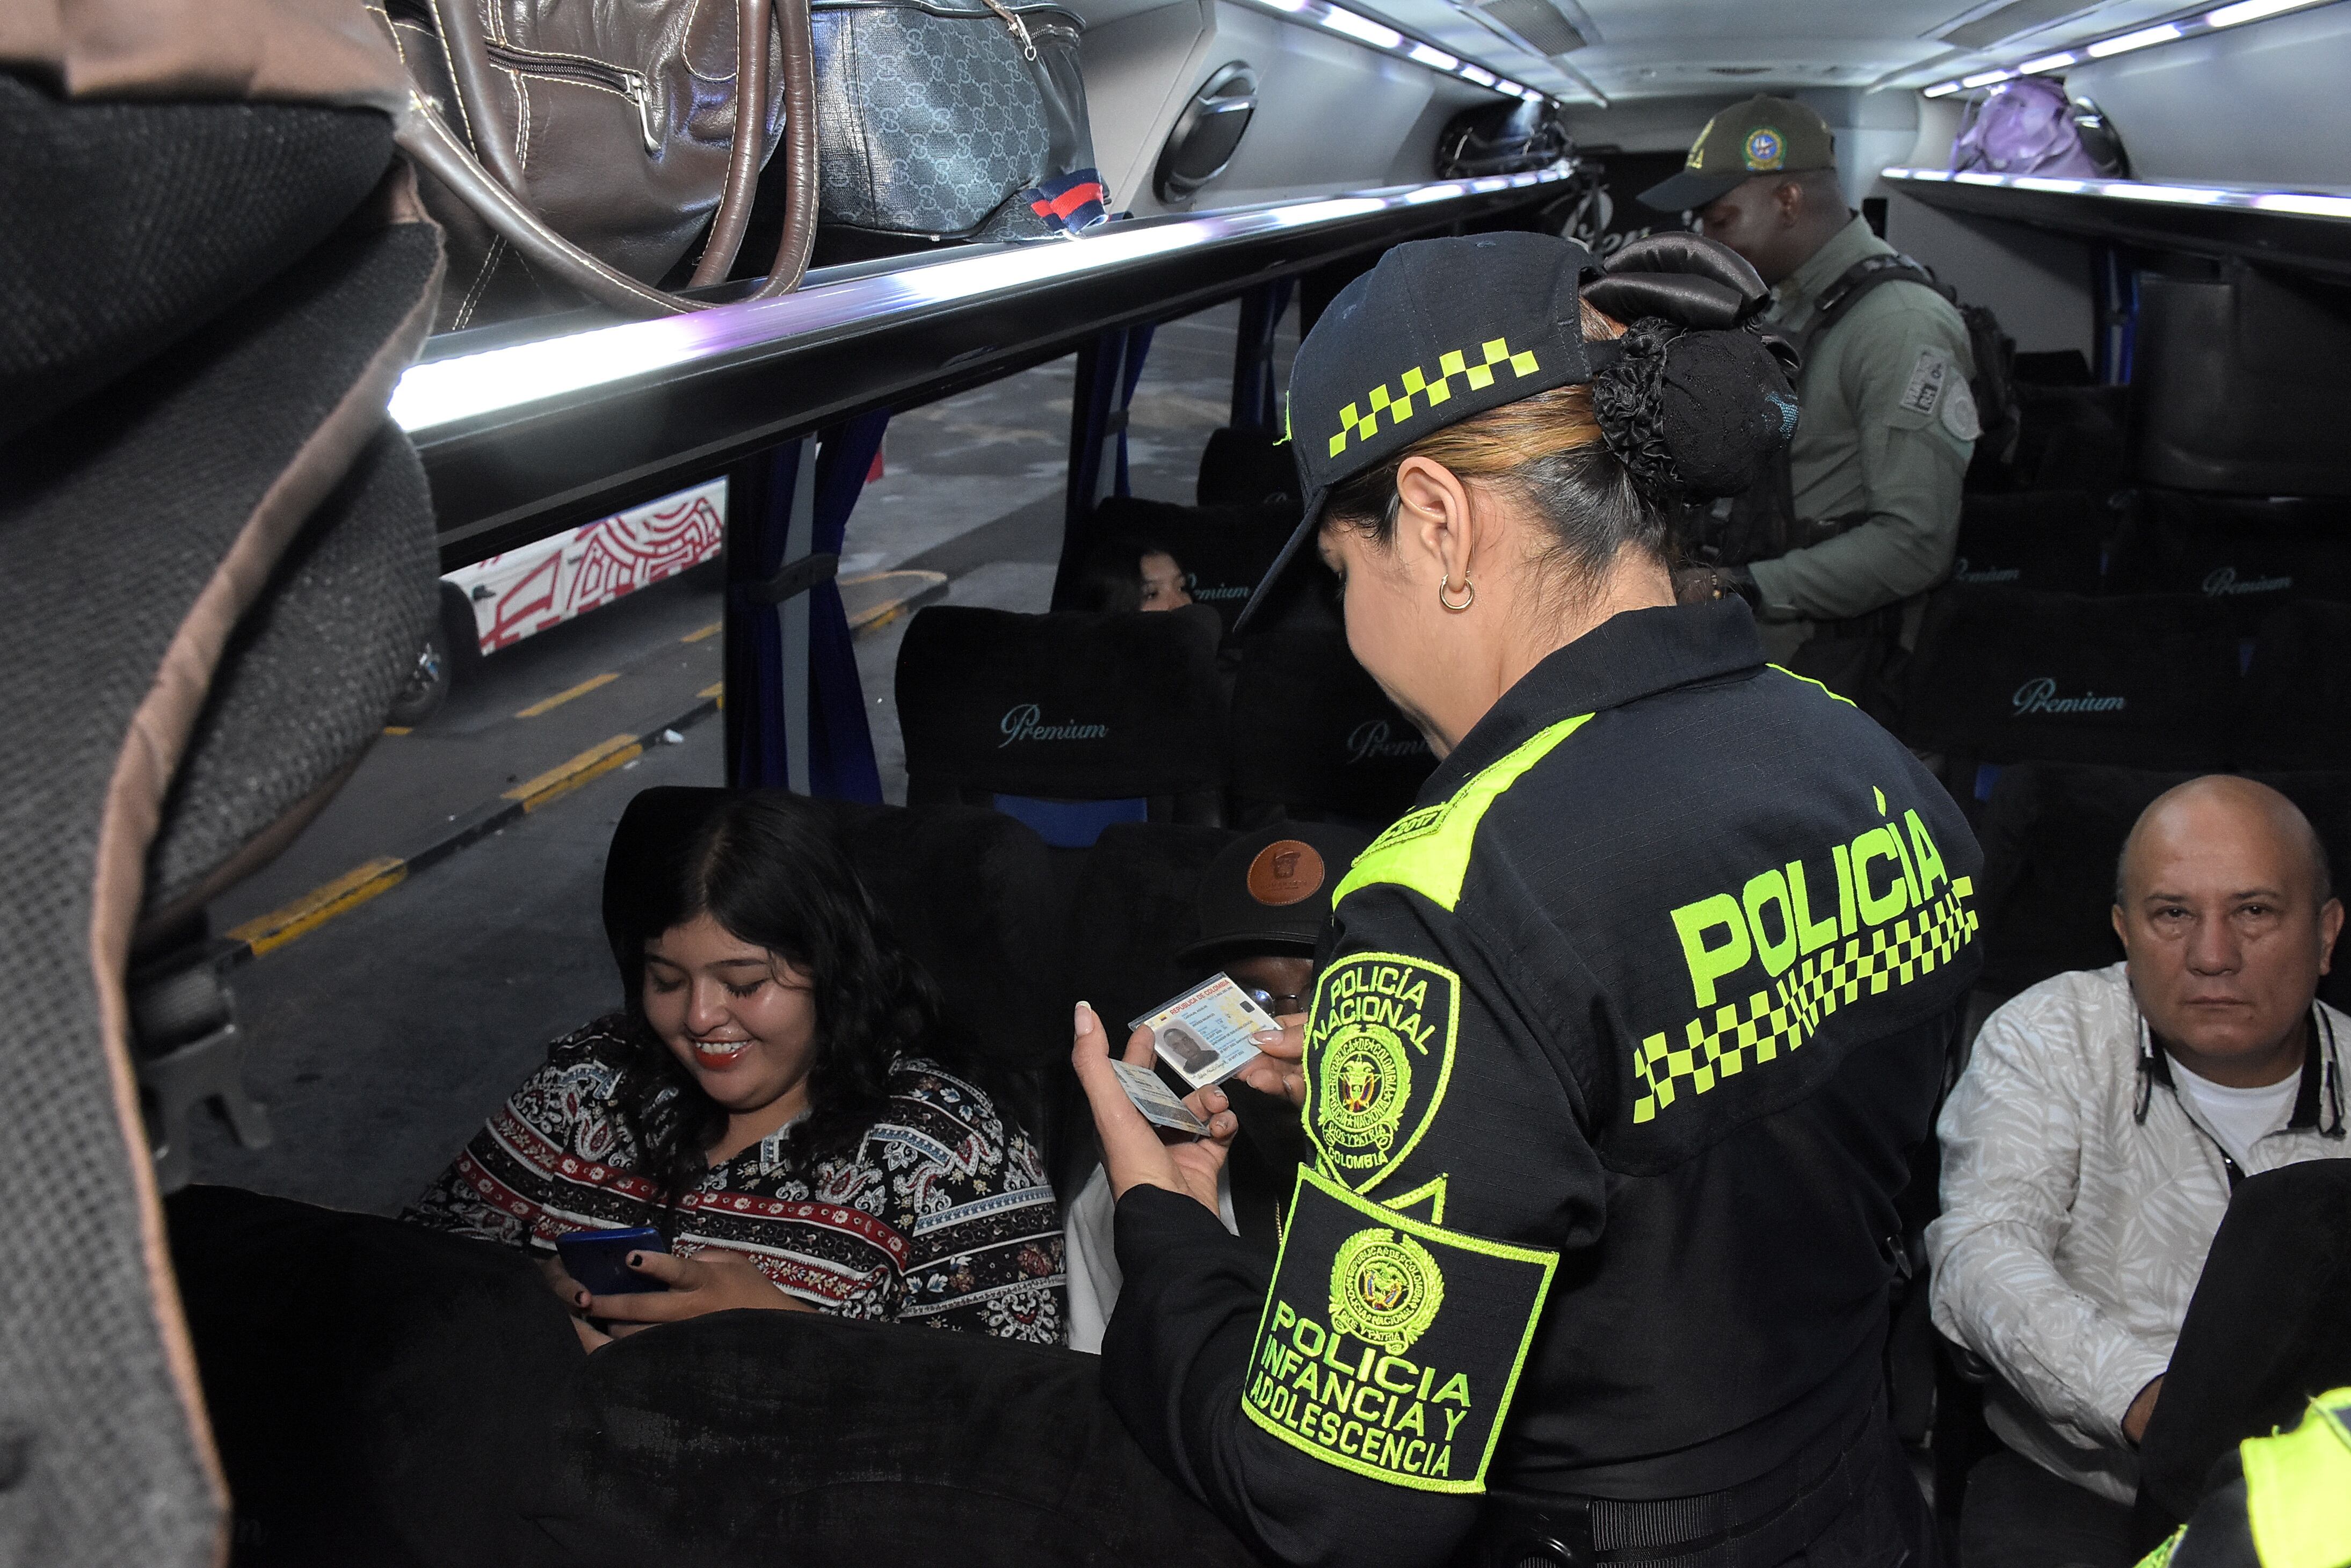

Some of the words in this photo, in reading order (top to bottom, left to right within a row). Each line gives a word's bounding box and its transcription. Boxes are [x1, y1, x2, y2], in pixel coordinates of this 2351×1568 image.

[2012, 677, 2124, 716] Premium
[998, 704, 1108, 748] Premium
[1671, 786, 1948, 1008] POLICÍA
[1170, 997, 1198, 1015] REPÚBLICA
[1204, 980, 1230, 996] COLOMBIA
[1330, 967, 1428, 1010] POLICÍA
[1312, 997, 1435, 1055] NACIONAL
[1359, 1038, 1370, 1050] DE
[1373, 1043, 1396, 1092] COLOMBIA
[1328, 1147, 1388, 1169] COLOMBIA
[1271, 1300, 1471, 1407] POLICIA
[1261, 1334, 1424, 1436] INFANCIA
[1445, 1408, 1467, 1441] Y
[1250, 1371, 1451, 1477] ADOLESCENCIA
